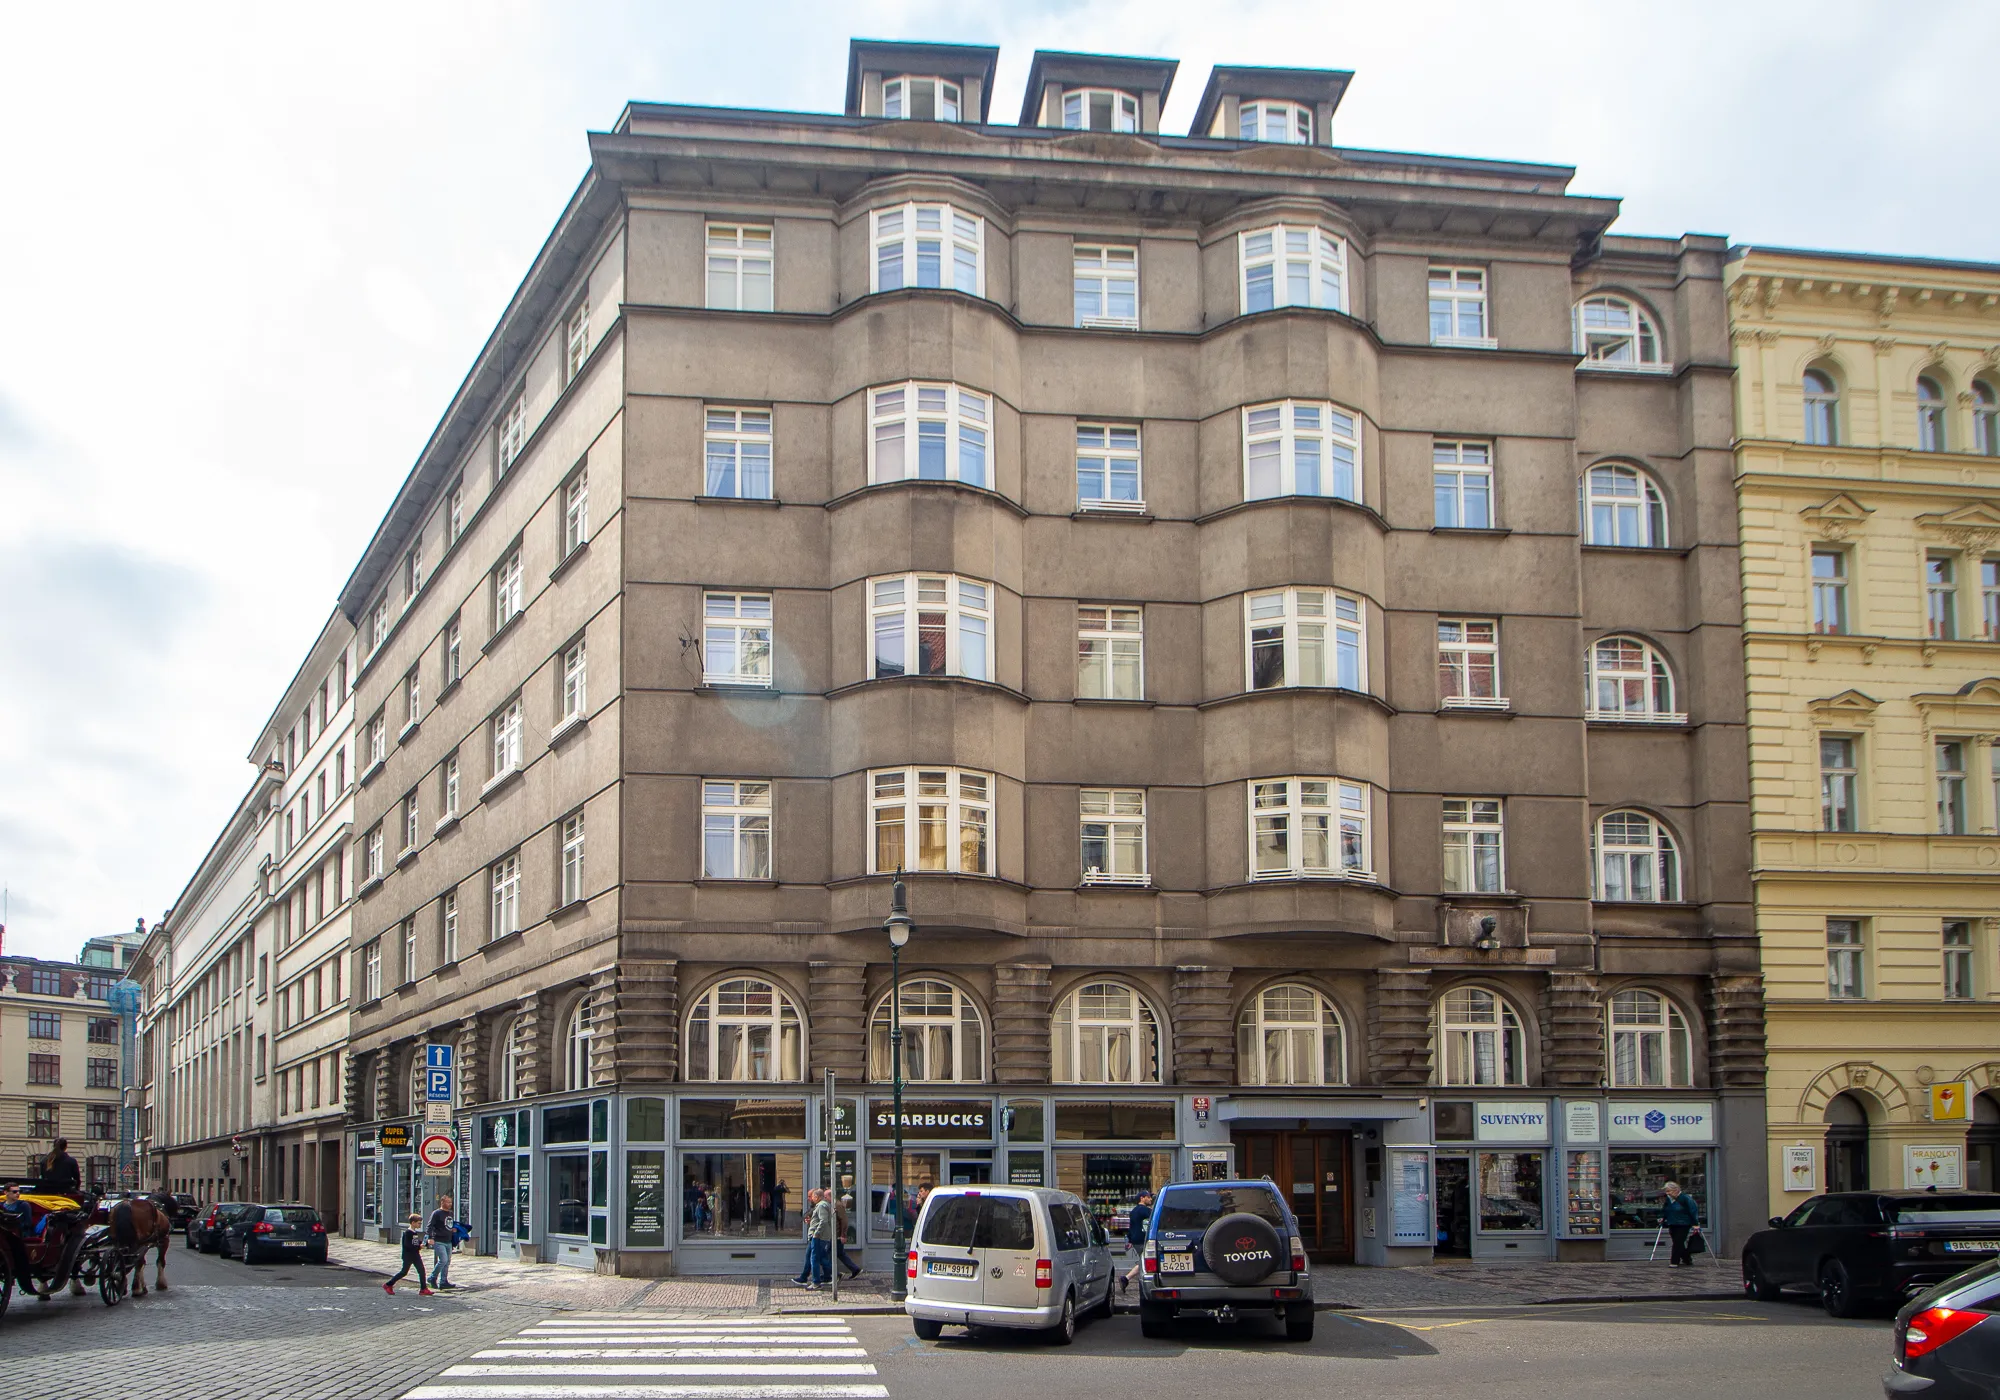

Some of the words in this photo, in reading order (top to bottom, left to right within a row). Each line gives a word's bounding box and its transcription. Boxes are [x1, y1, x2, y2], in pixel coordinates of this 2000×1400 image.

[432, 1072, 447, 1091] P
[877, 1113, 984, 1126] STARBUCKS
[1480, 1112, 1544, 1125] SUVENÝRY
[1613, 1115, 1640, 1125] GIFT
[1670, 1115, 1703, 1125] SHOP
[385, 1127, 404, 1135] SUPER
[382, 1137, 407, 1145] MARKET
[1912, 1150, 1957, 1158] HRANOLKY
[1952, 1241, 1971, 1249] 9AC
[1170, 1254, 1182, 1263] BT
[1224, 1250, 1272, 1262] TOYOTA
[933, 1262, 947, 1273] 6AH
[951, 1264, 970, 1274] 9911
[1162, 1262, 1191, 1271] 542BT
